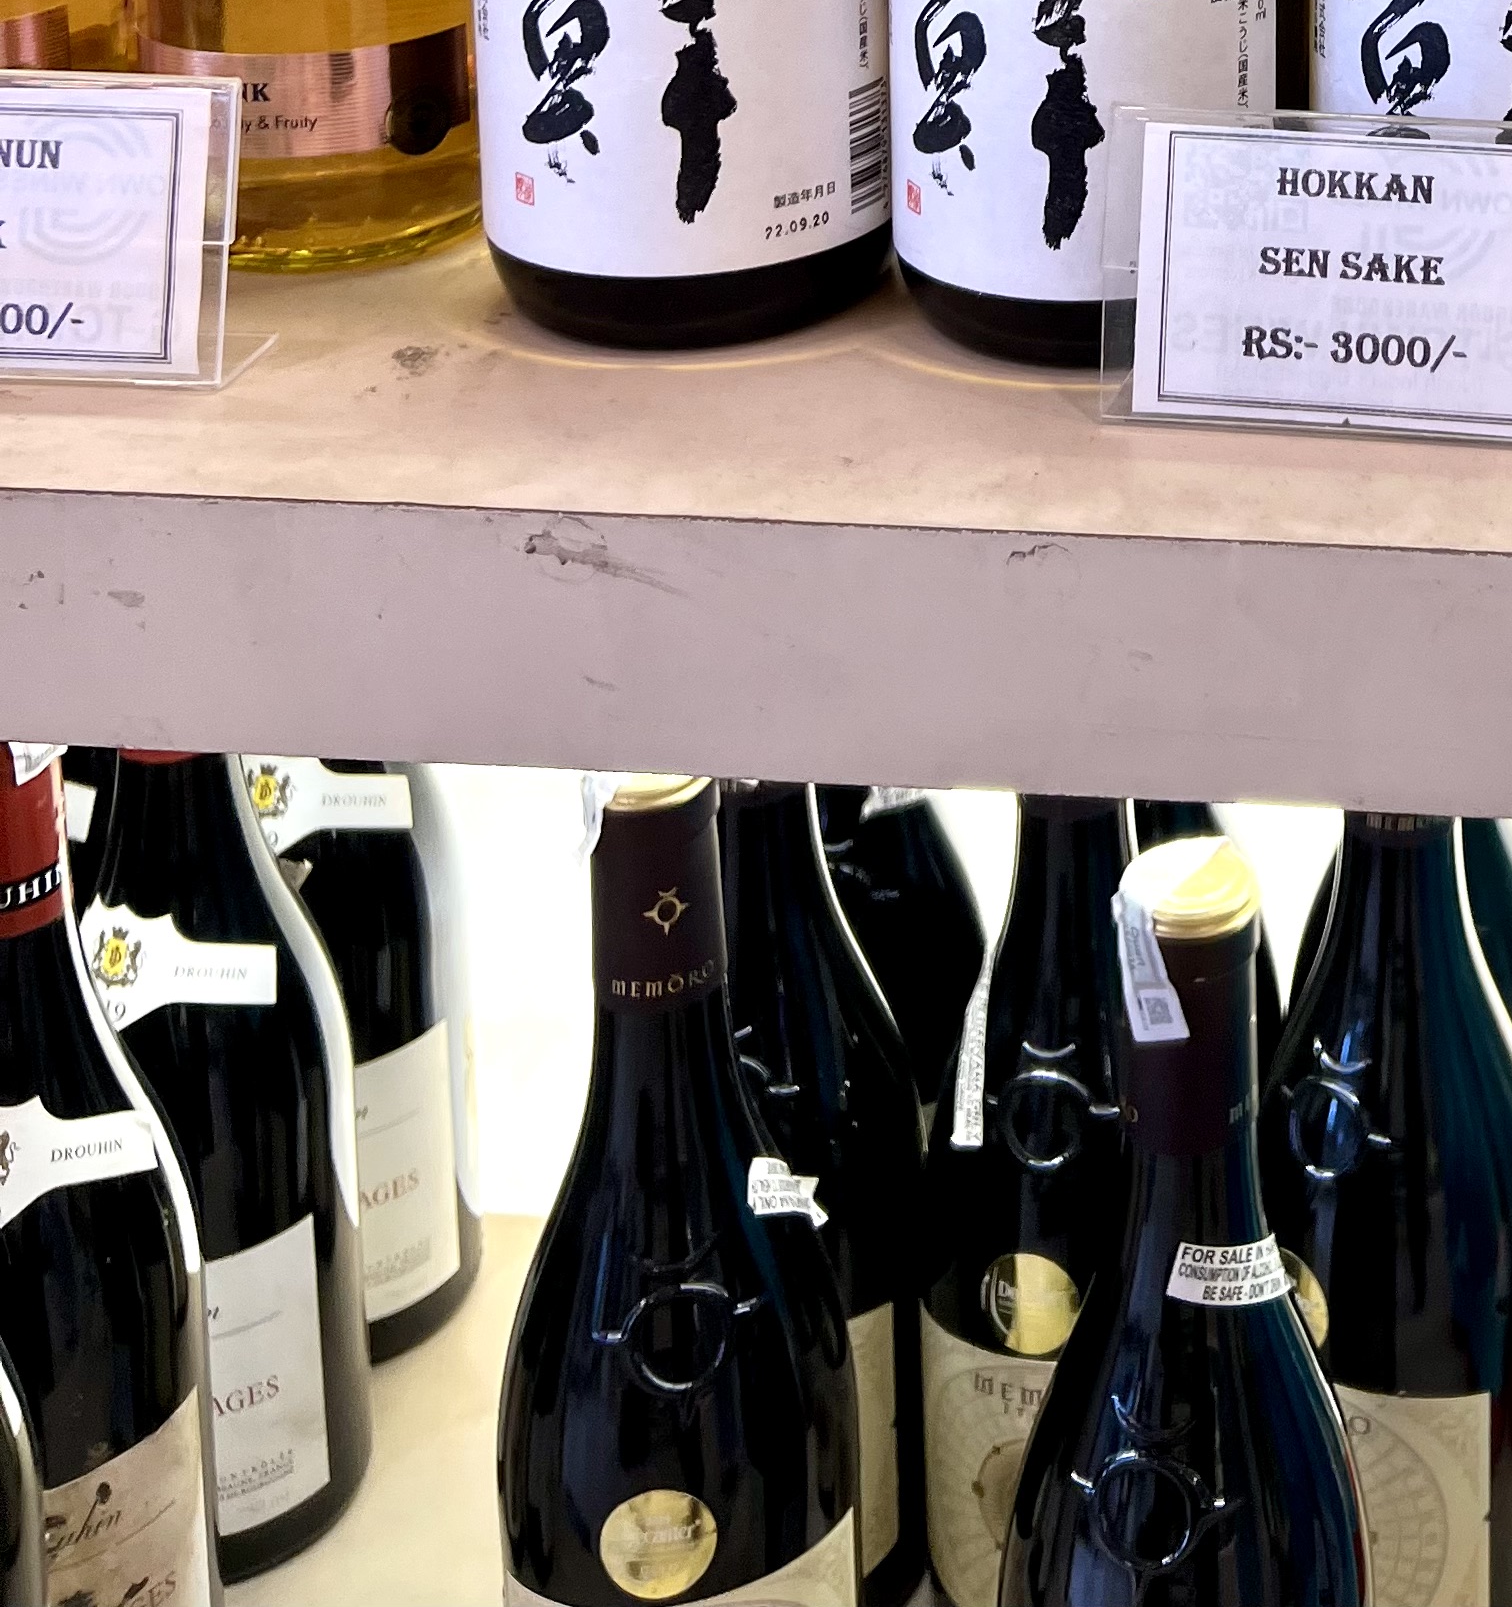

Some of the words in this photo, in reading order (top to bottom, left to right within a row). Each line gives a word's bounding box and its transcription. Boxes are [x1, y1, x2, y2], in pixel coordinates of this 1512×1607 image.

[1277, 167, 1435, 204] HOKKAN
[1258, 246, 1330, 279] SEN
[1340, 251, 1446, 285] SAKE
[1330, 331, 1467, 373] 3000/-
[50, 1137, 123, 1163] DROUHIN
[1182, 1246, 1216, 1264] FOR
[1219, 1247, 1253, 1265] SALE
